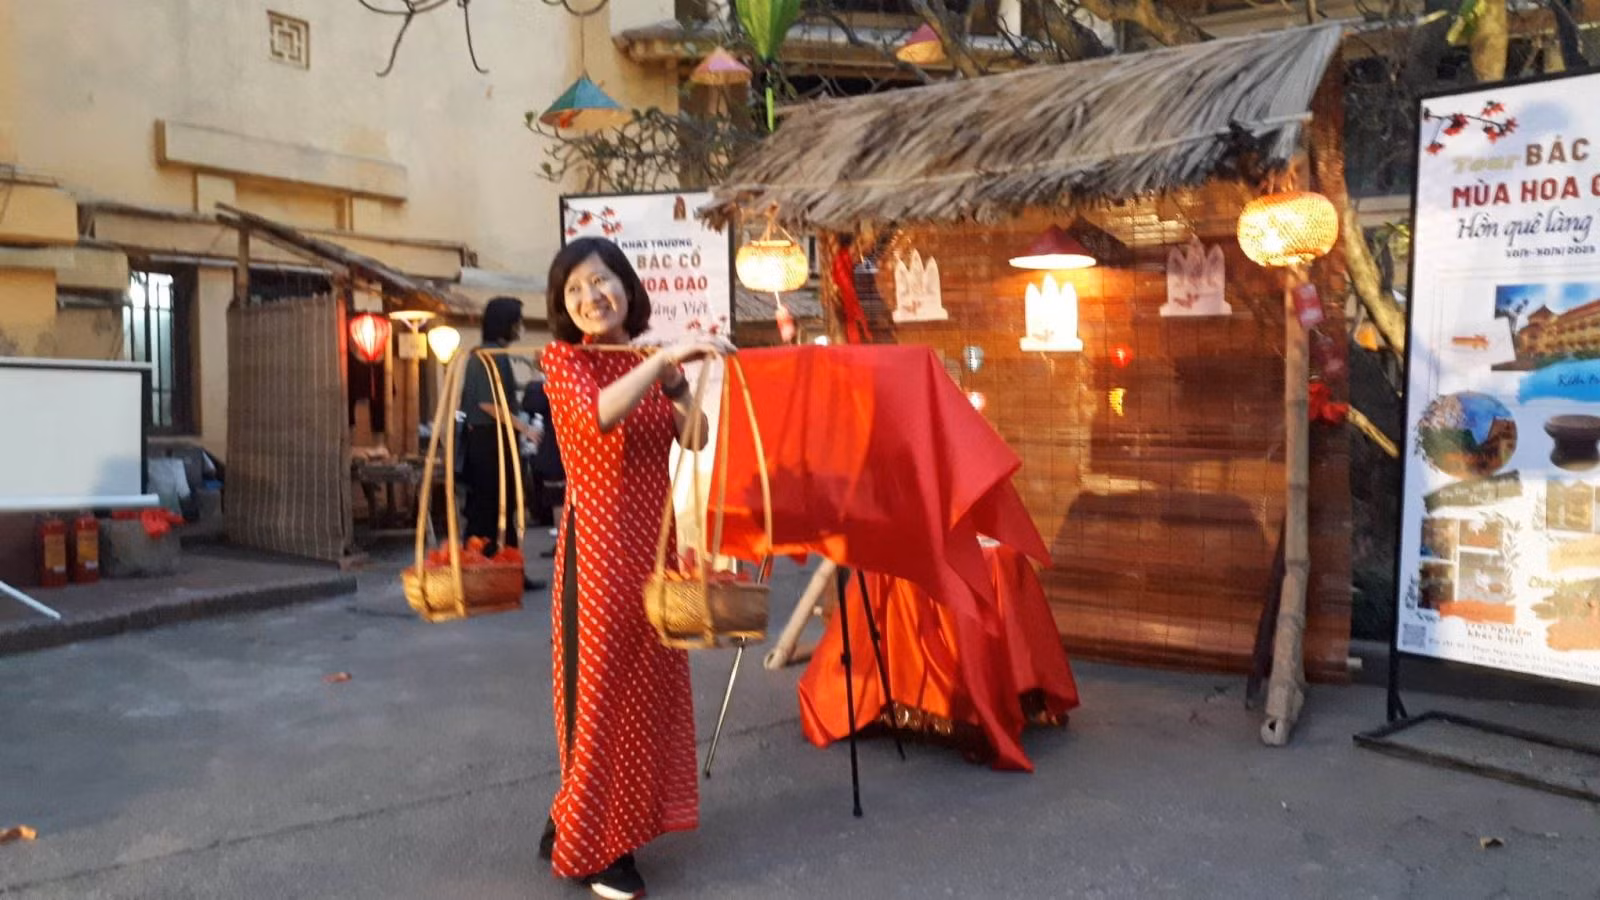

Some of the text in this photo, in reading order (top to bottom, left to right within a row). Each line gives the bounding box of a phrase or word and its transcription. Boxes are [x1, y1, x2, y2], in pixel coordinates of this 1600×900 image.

[1452, 179, 1510, 208] MÙA
[1521, 176, 1580, 203] HOA
[1545, 206, 1593, 243] làng
[674, 276, 707, 296] GẠO
